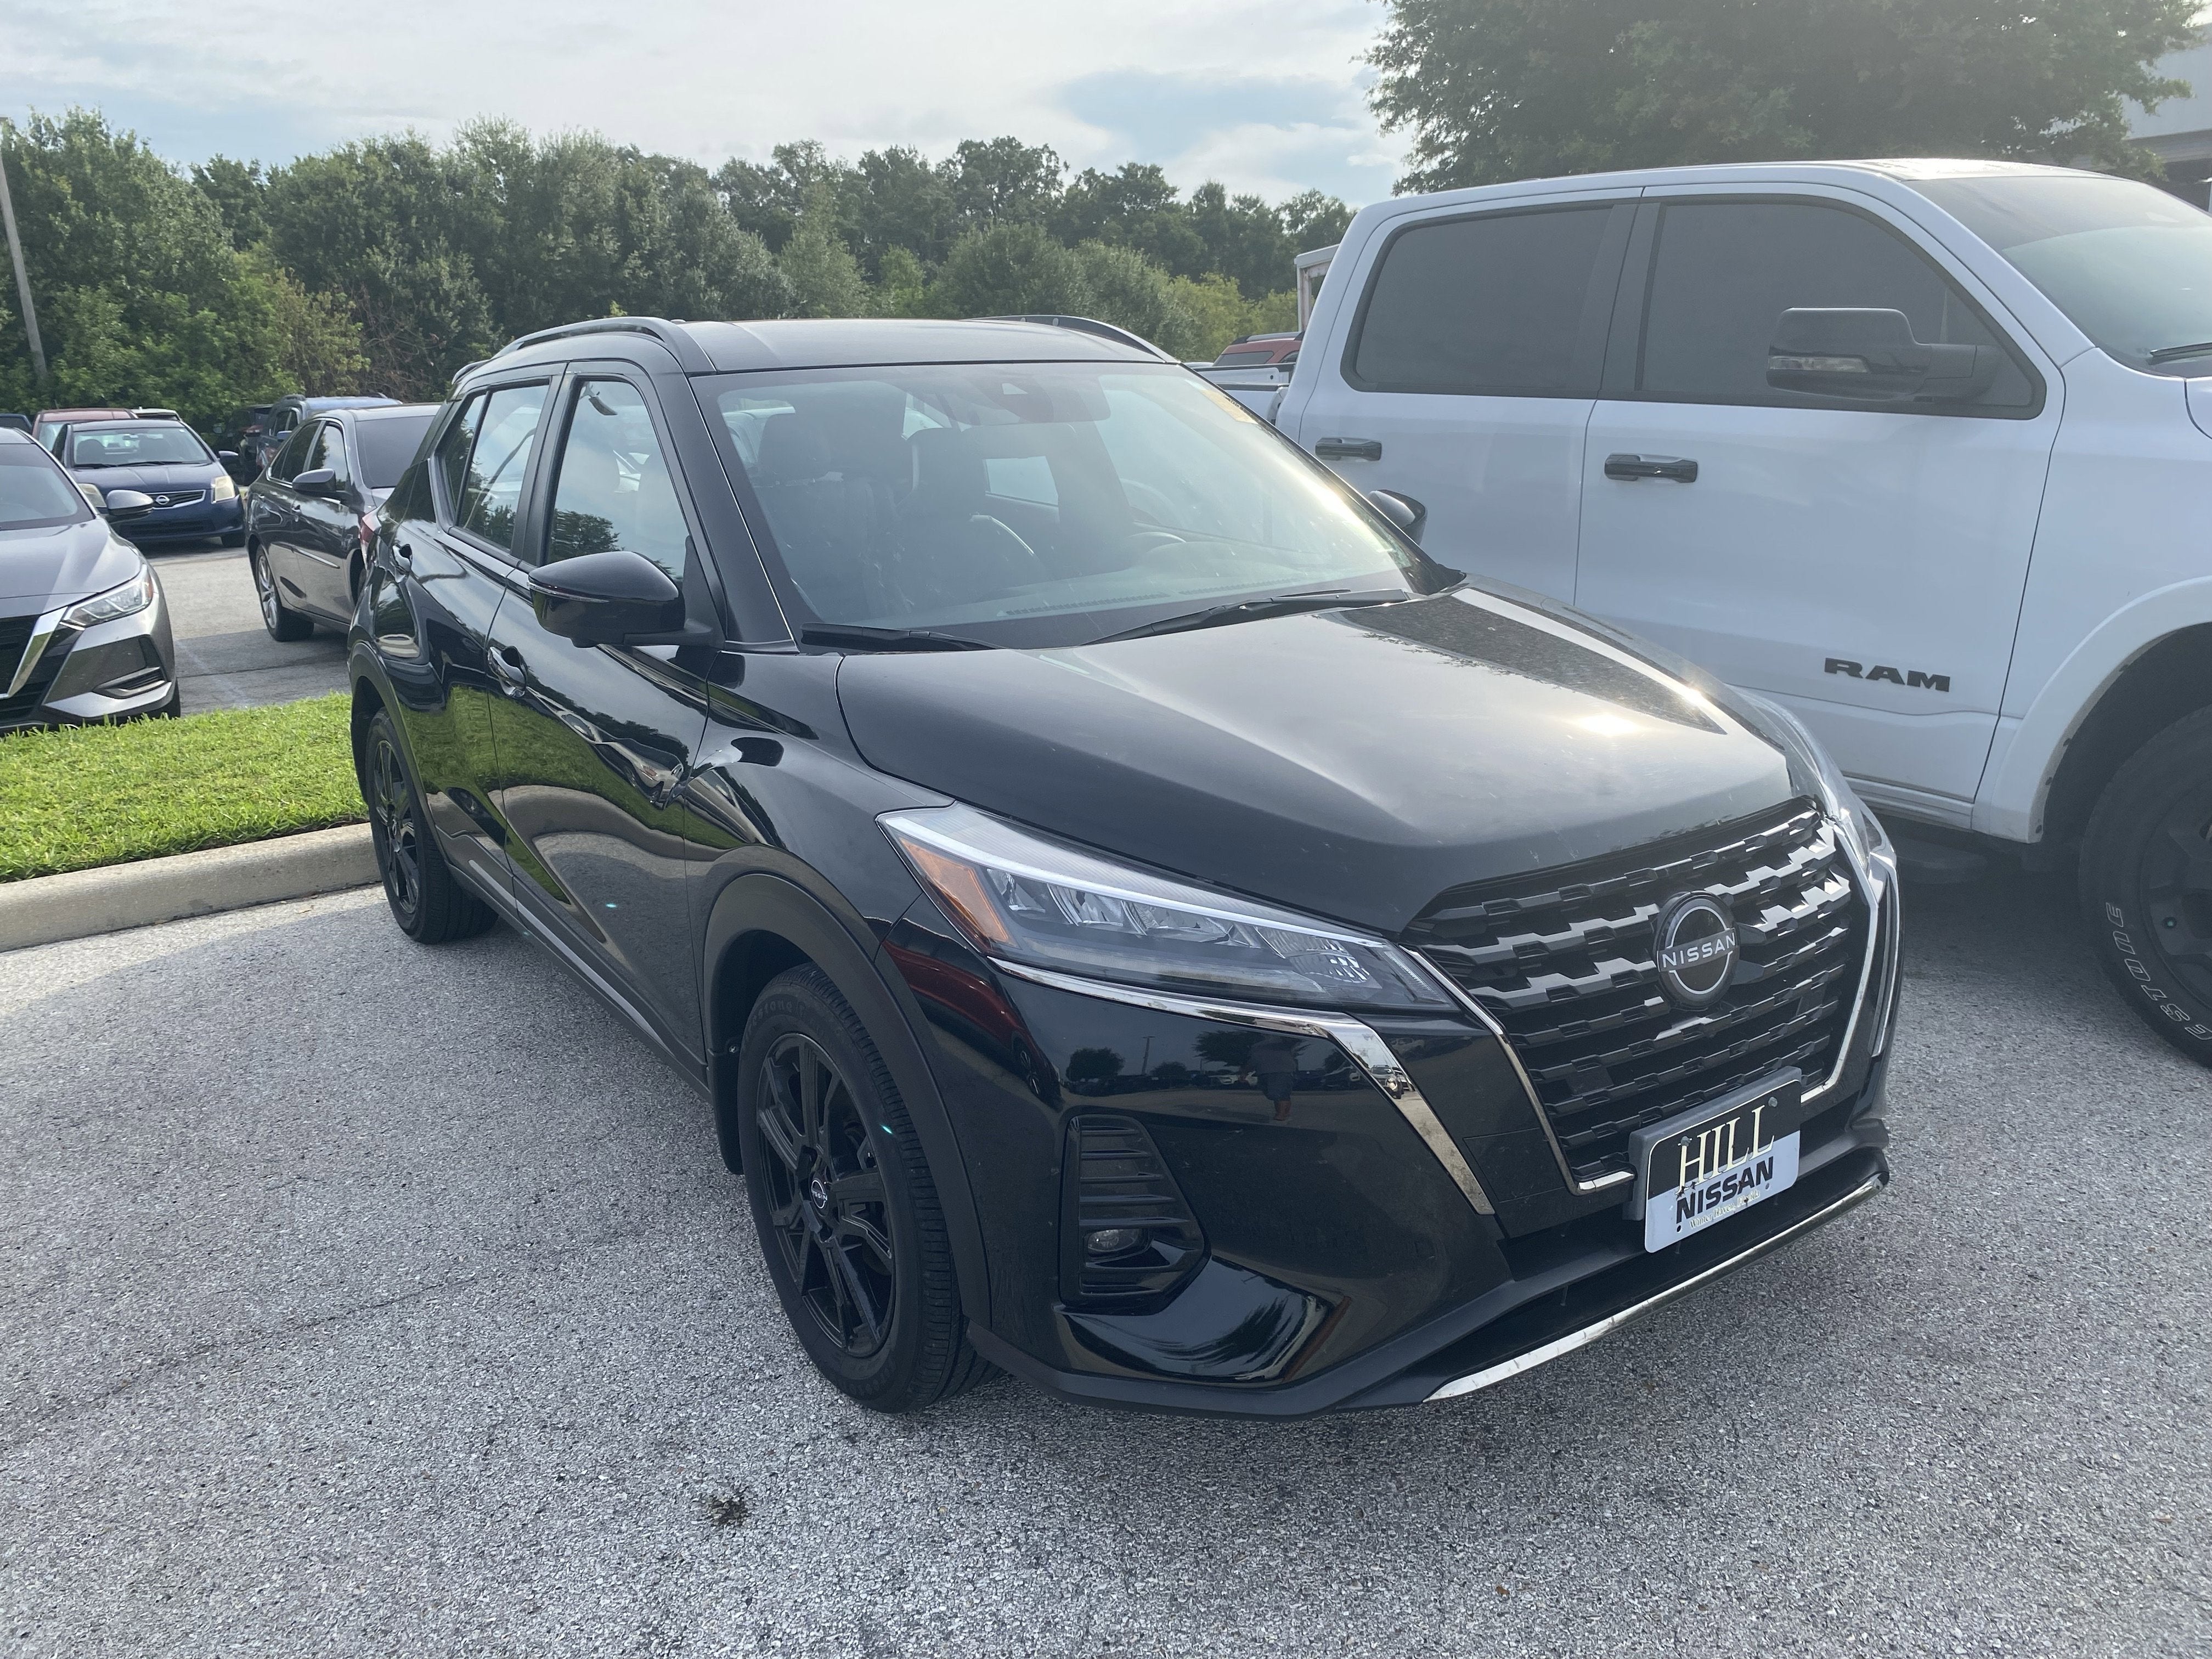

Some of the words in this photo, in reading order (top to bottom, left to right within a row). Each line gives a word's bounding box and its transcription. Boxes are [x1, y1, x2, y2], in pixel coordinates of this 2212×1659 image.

[1824, 657, 1950, 692] RAM
[1662, 932, 1736, 968] NISSAN
[1675, 1105, 1775, 1195] HILL
[811, 1191, 828, 1200] NISS
[1676, 1156, 1774, 1223] NISSAN
[1689, 1212, 1712, 1229] Winter
[1713, 1201, 1736, 1219] Haven,
[1737, 1190, 1760, 1209] Flrida
